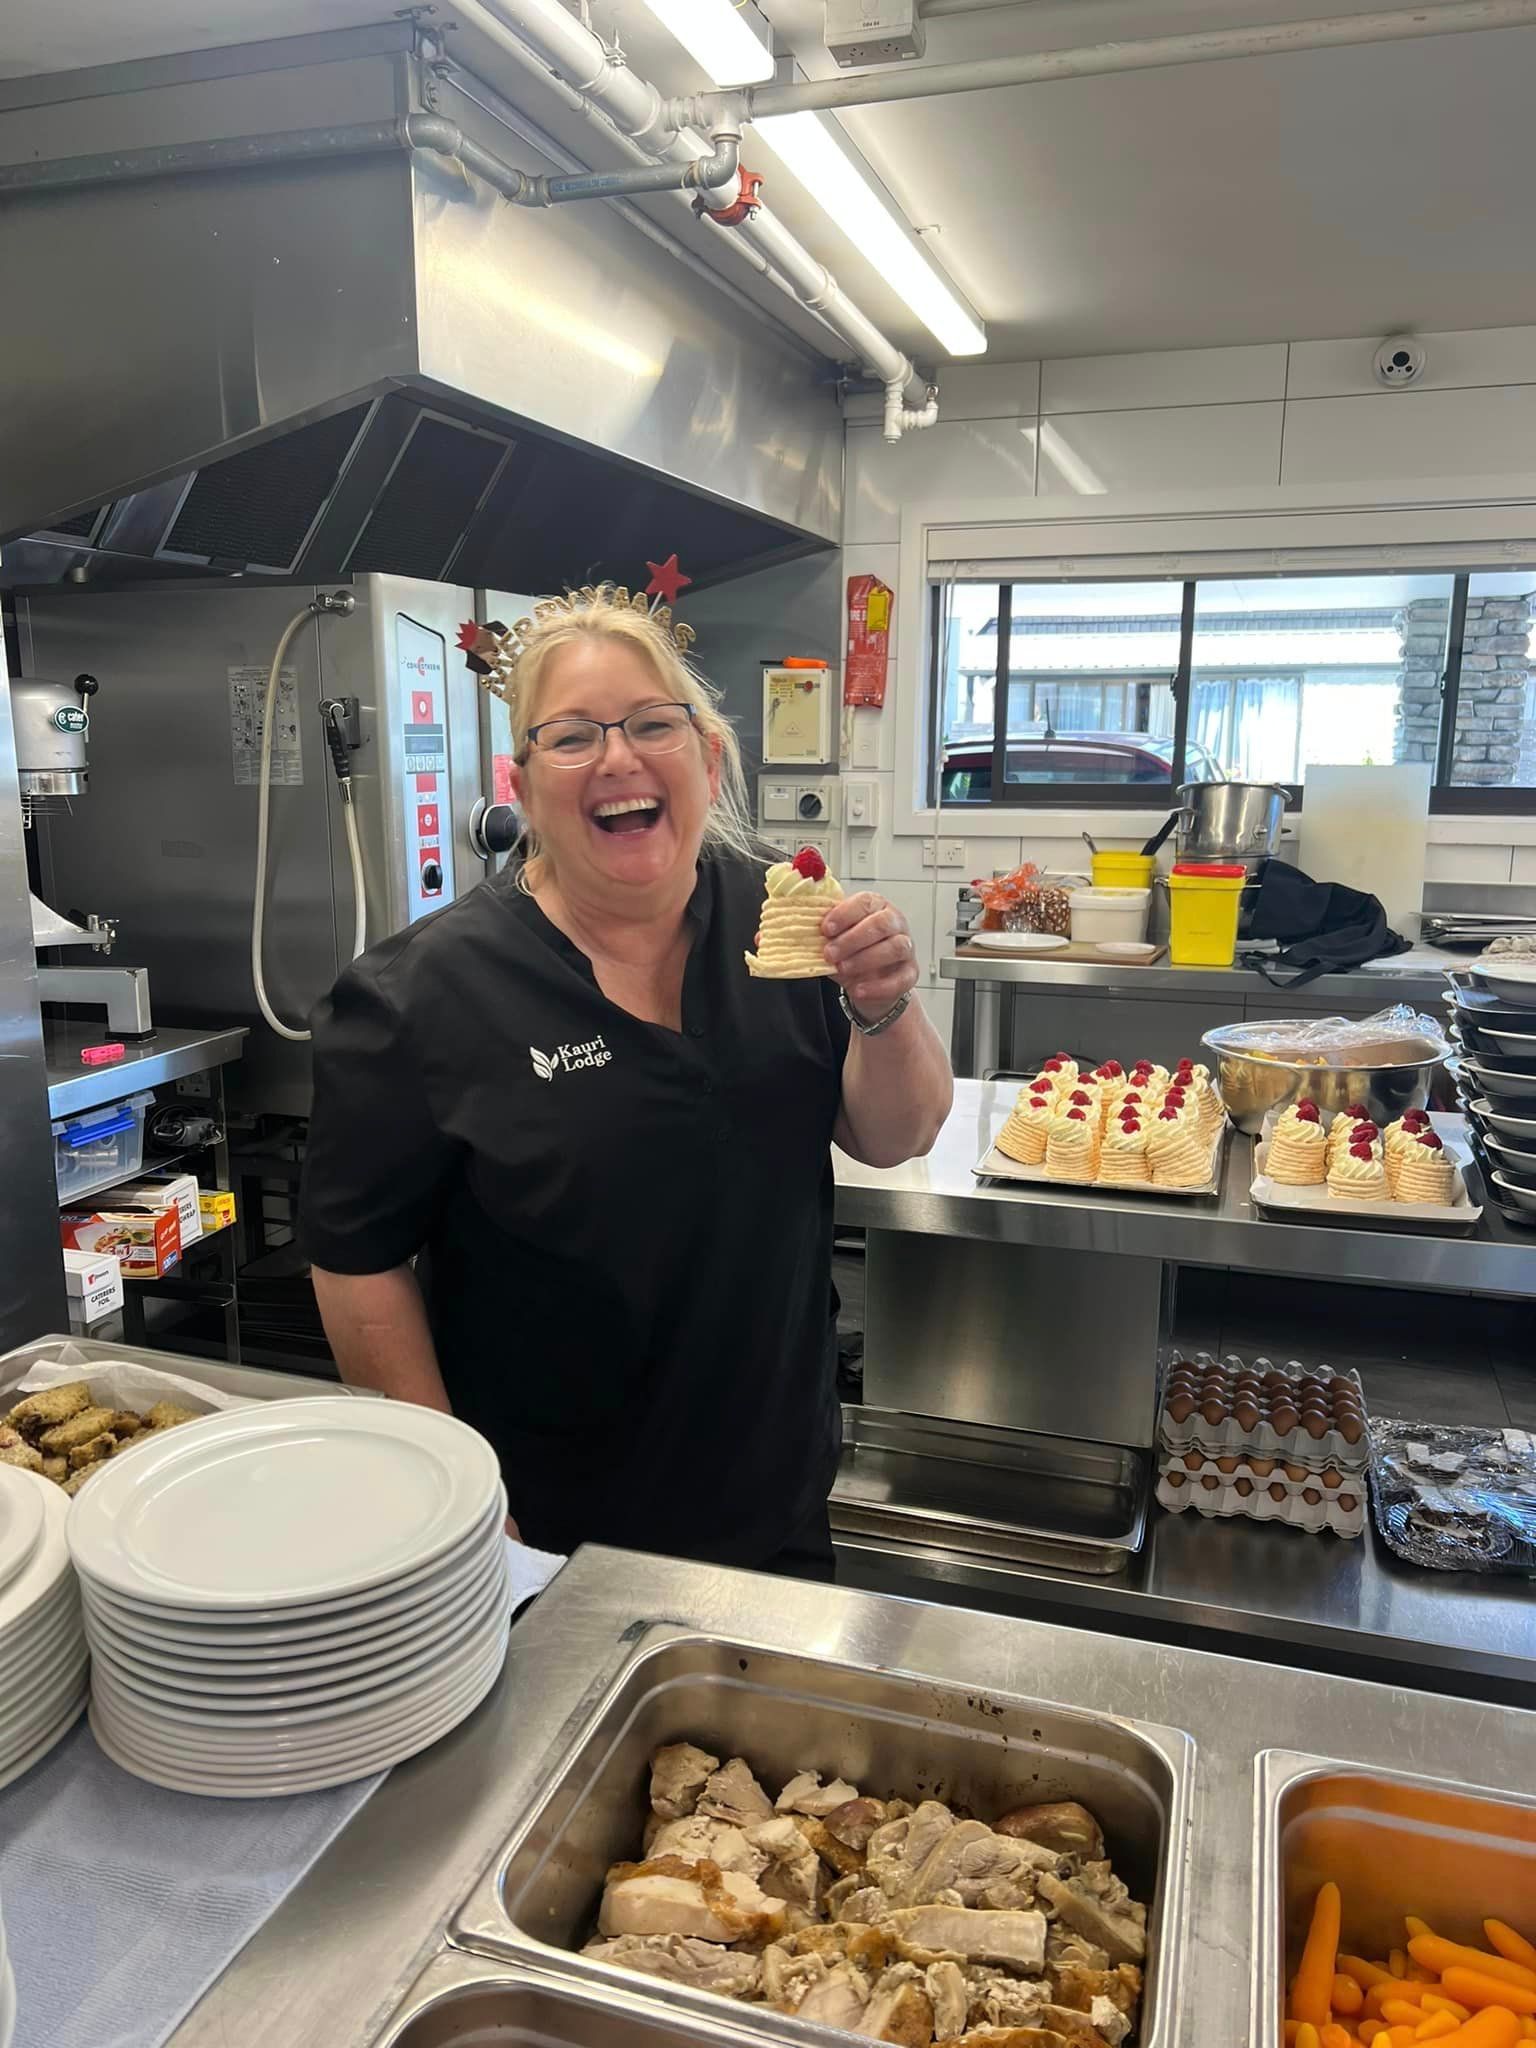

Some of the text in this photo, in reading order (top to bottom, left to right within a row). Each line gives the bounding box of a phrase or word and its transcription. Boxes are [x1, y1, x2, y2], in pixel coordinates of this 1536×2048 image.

[67, 711, 84, 722] cater
[557, 1034, 607, 1059] Kauri
[561, 1050, 613, 1072] Lodge
[91, 1286, 116, 1303] CATERERS
[98, 1297, 111, 1307] FOIL
